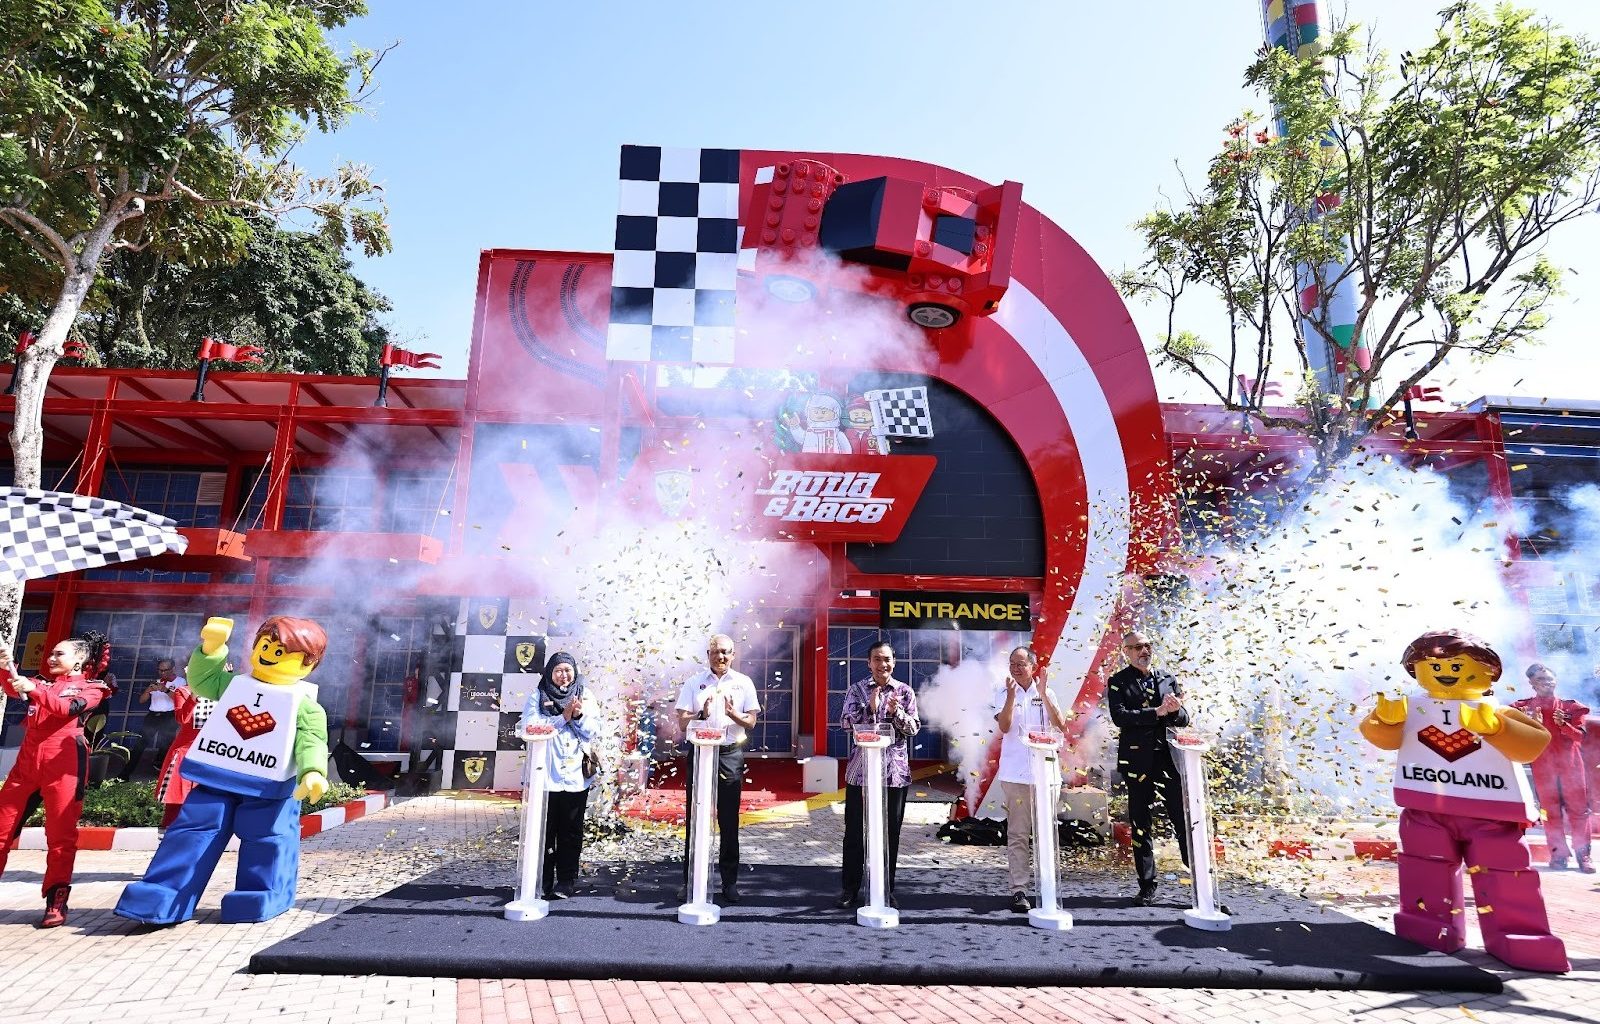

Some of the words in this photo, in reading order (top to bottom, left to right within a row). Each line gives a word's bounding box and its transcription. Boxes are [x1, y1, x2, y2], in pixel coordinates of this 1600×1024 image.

[780, 496, 895, 523] Race
[889, 601, 1022, 620] ENTRANCE
[253, 693, 263, 707] I
[1442, 709, 1451, 725] I
[198, 738, 278, 768] LEGOLAND
[1402, 766, 1505, 790] LEGOLAND
